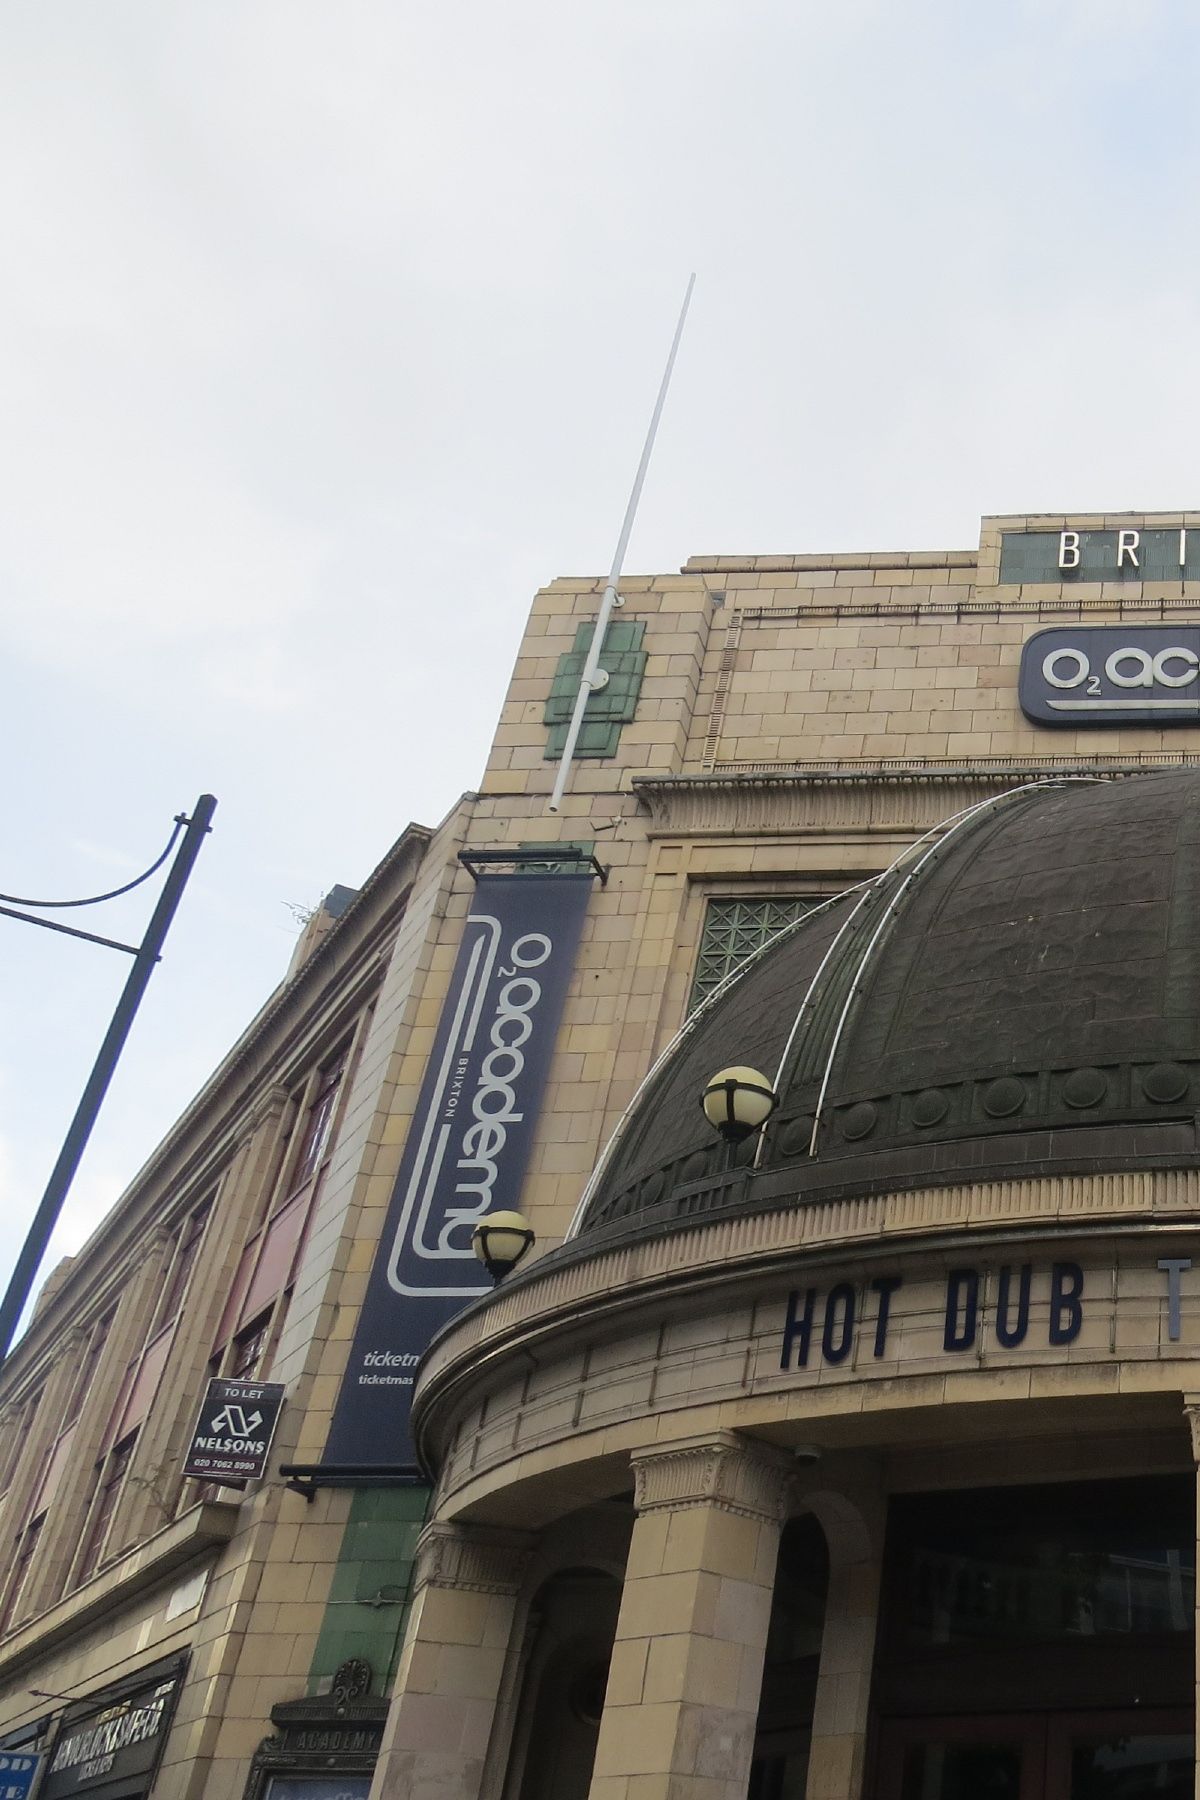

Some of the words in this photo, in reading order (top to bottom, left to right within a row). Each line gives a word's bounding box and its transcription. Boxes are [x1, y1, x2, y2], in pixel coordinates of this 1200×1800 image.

[446, 1056, 468, 1118] BRIXTON
[780, 1277, 902, 1369] HOT
[943, 1262, 1085, 1350] DUB
[224, 1388, 240, 1397] TO
[241, 1390, 264, 1399] LET
[194, 1437, 266, 1454] NELSONS
[194, 1458, 211, 1467] 020
[296, 1730, 377, 1750] ACADEMY
